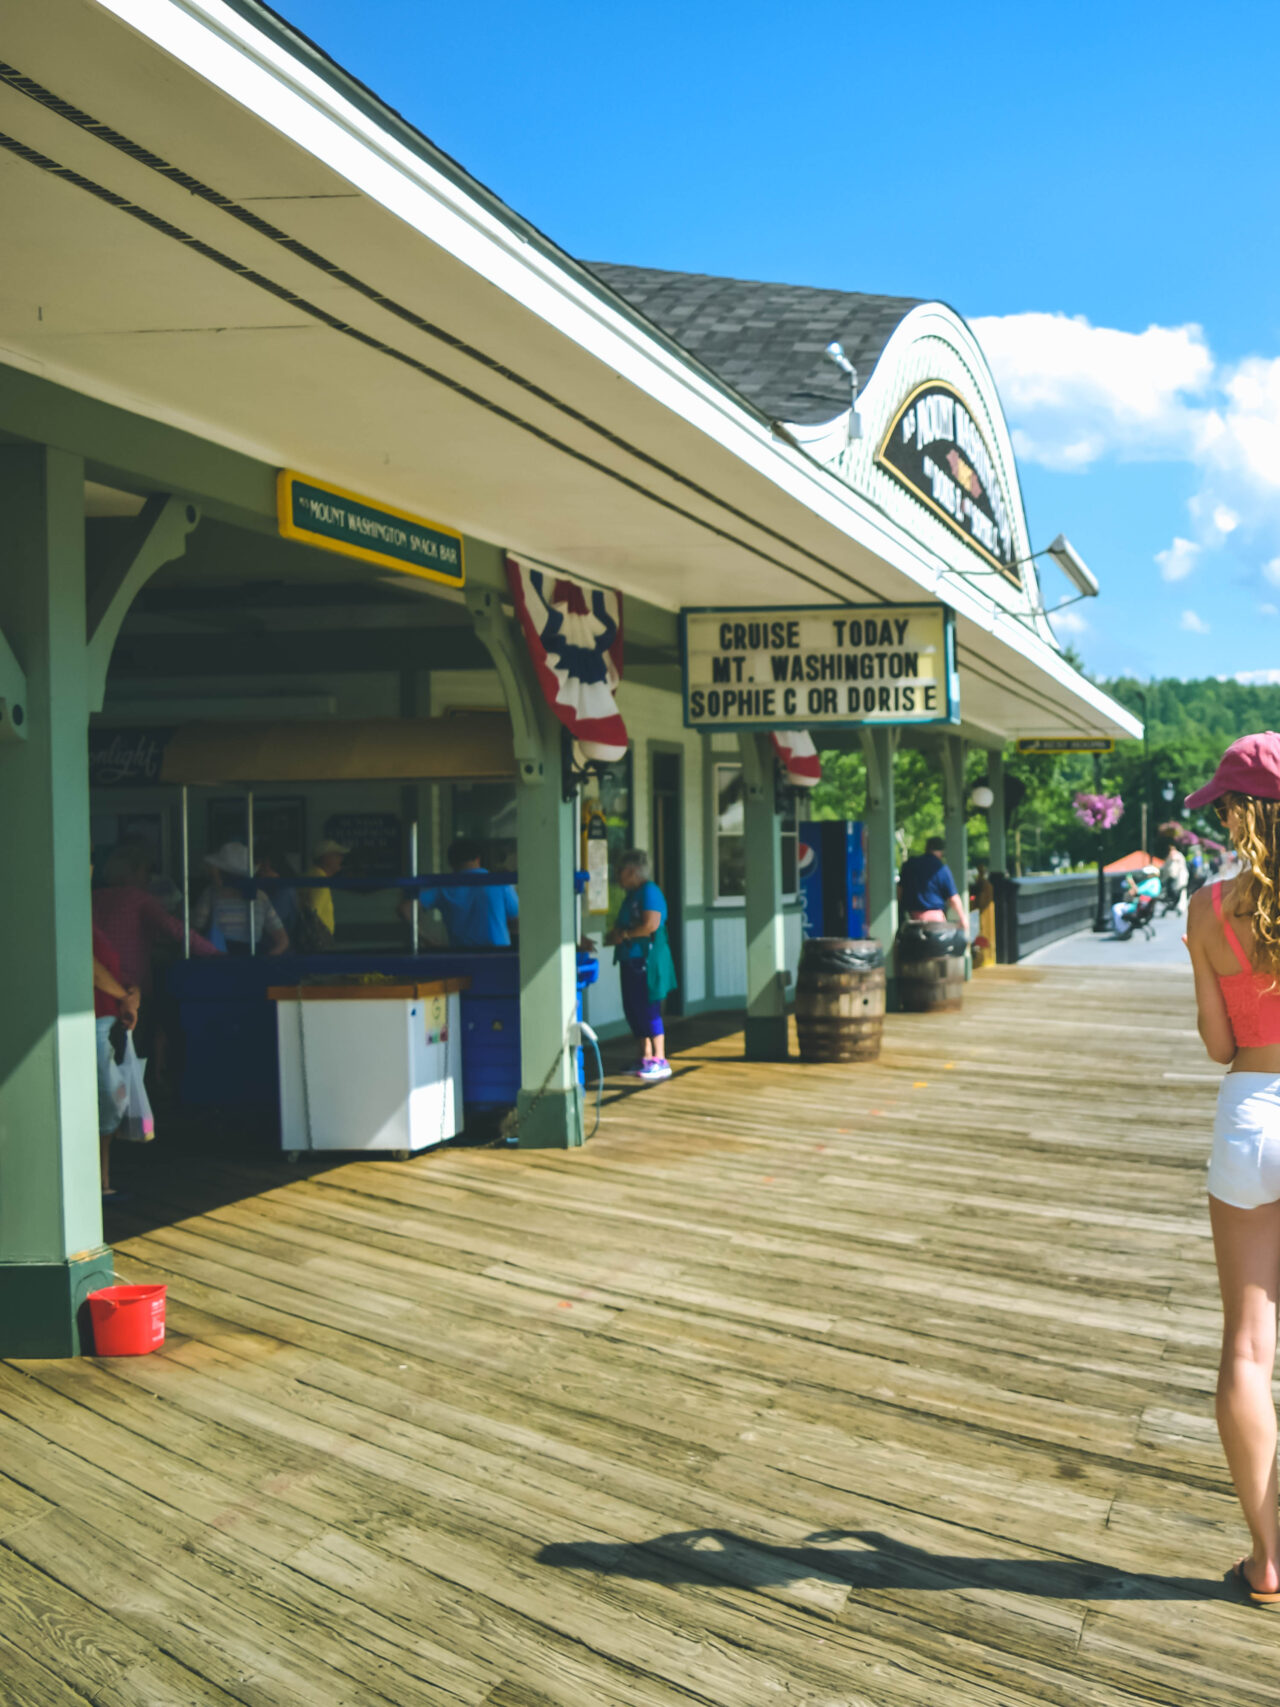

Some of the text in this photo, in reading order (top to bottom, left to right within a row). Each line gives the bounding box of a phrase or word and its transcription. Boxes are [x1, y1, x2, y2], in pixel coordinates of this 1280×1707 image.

[310, 499, 344, 528] MOUNT
[347, 512, 407, 548] WASHINGTON
[719, 618, 909, 650] CRUISE TODAY
[712, 652, 919, 683] MT. WASHINGTON
[690, 685, 937, 718] SOPHIE C OR DORIS E
